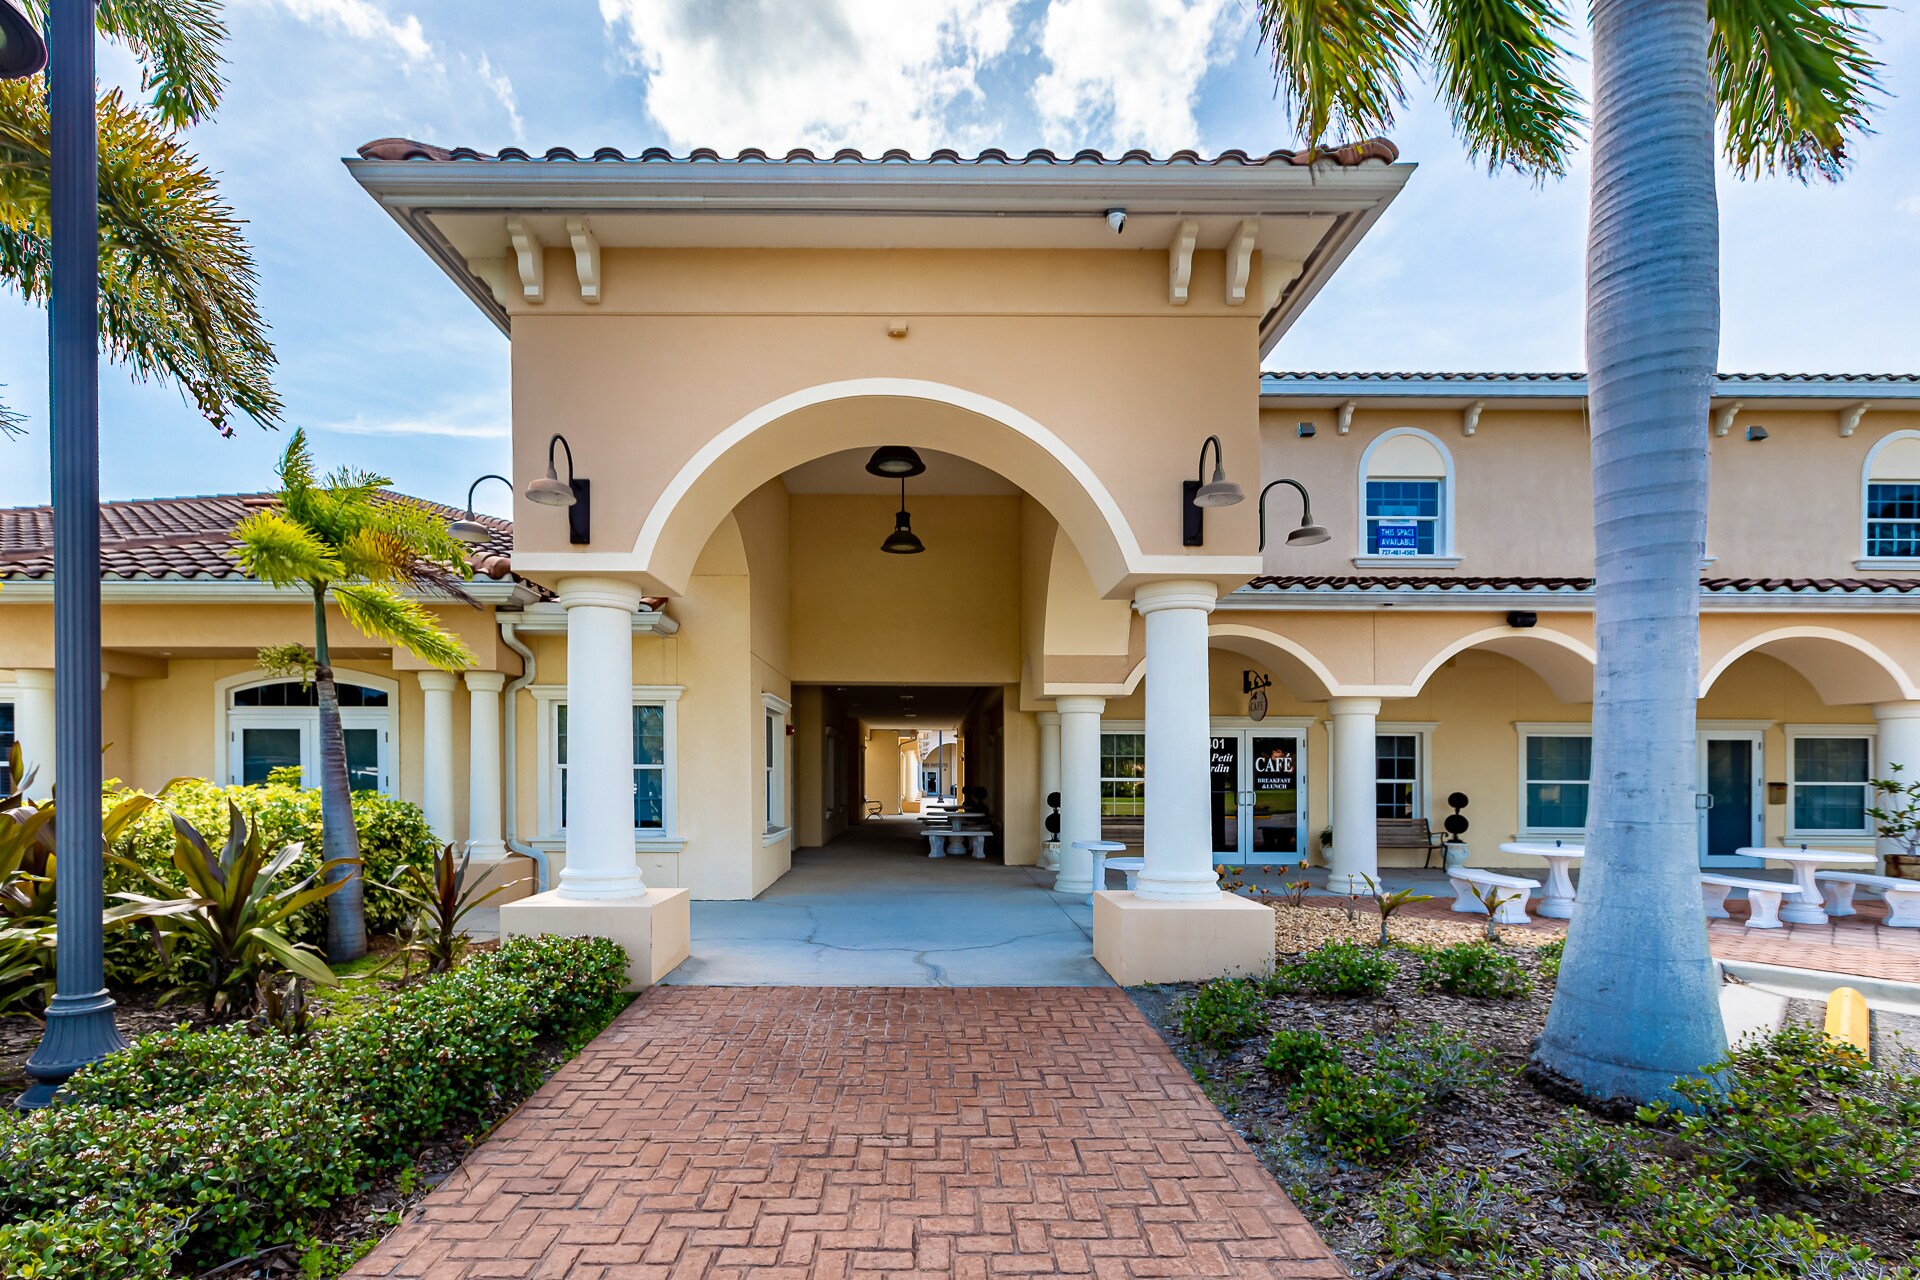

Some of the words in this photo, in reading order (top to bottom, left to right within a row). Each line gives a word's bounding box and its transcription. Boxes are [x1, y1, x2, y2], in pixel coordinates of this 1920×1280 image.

[1381, 528, 1395, 536] THIS
[1397, 528, 1414, 536] SPACE
[1381, 538, 1415, 546] AVAILABLE
[1210, 738, 1225, 750] 01
[1211, 753, 1234, 763] Petit
[1255, 753, 1293, 773] CAFÉ
[1210, 763, 1230, 773] rdin
